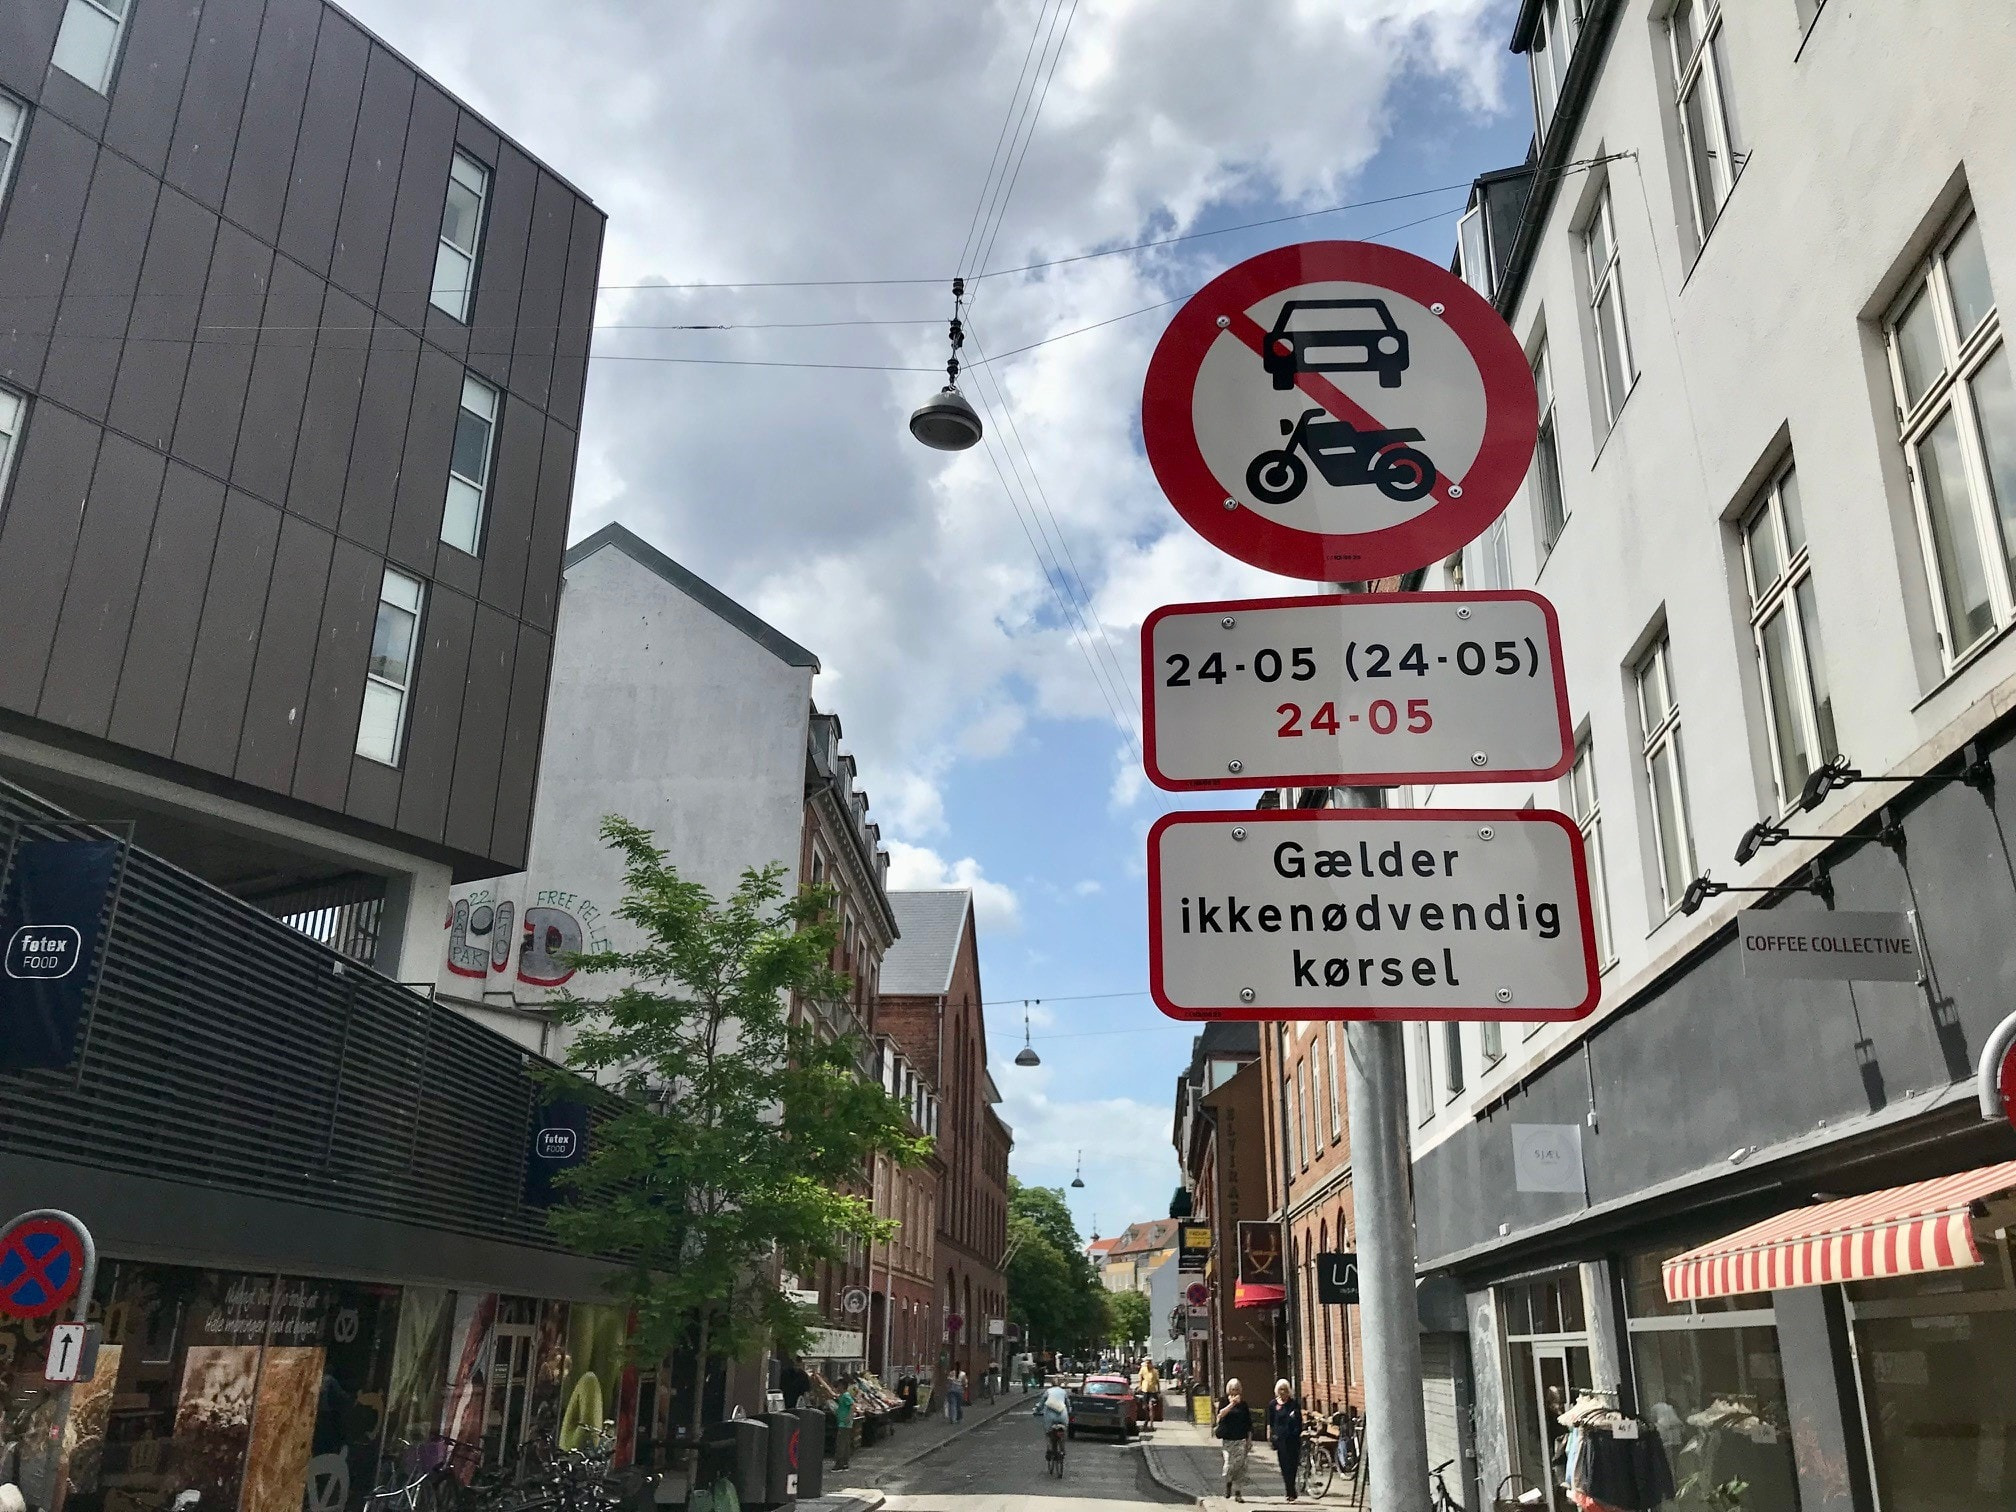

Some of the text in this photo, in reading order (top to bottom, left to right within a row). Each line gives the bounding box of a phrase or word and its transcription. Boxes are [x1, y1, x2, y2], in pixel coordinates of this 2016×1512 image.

[1166, 637, 1539, 687] 24-05 (24-05)
[1276, 699, 1434, 738] 24-05
[1273, 841, 1459, 879] Gælder
[537, 890, 578, 910] FREE
[1181, 894, 1561, 939] ikkenødvendig
[23, 956, 58, 968] FOOD
[1746, 935, 1913, 954] COFFEE COLLECTIVE
[1293, 948, 1459, 987] kørsel
